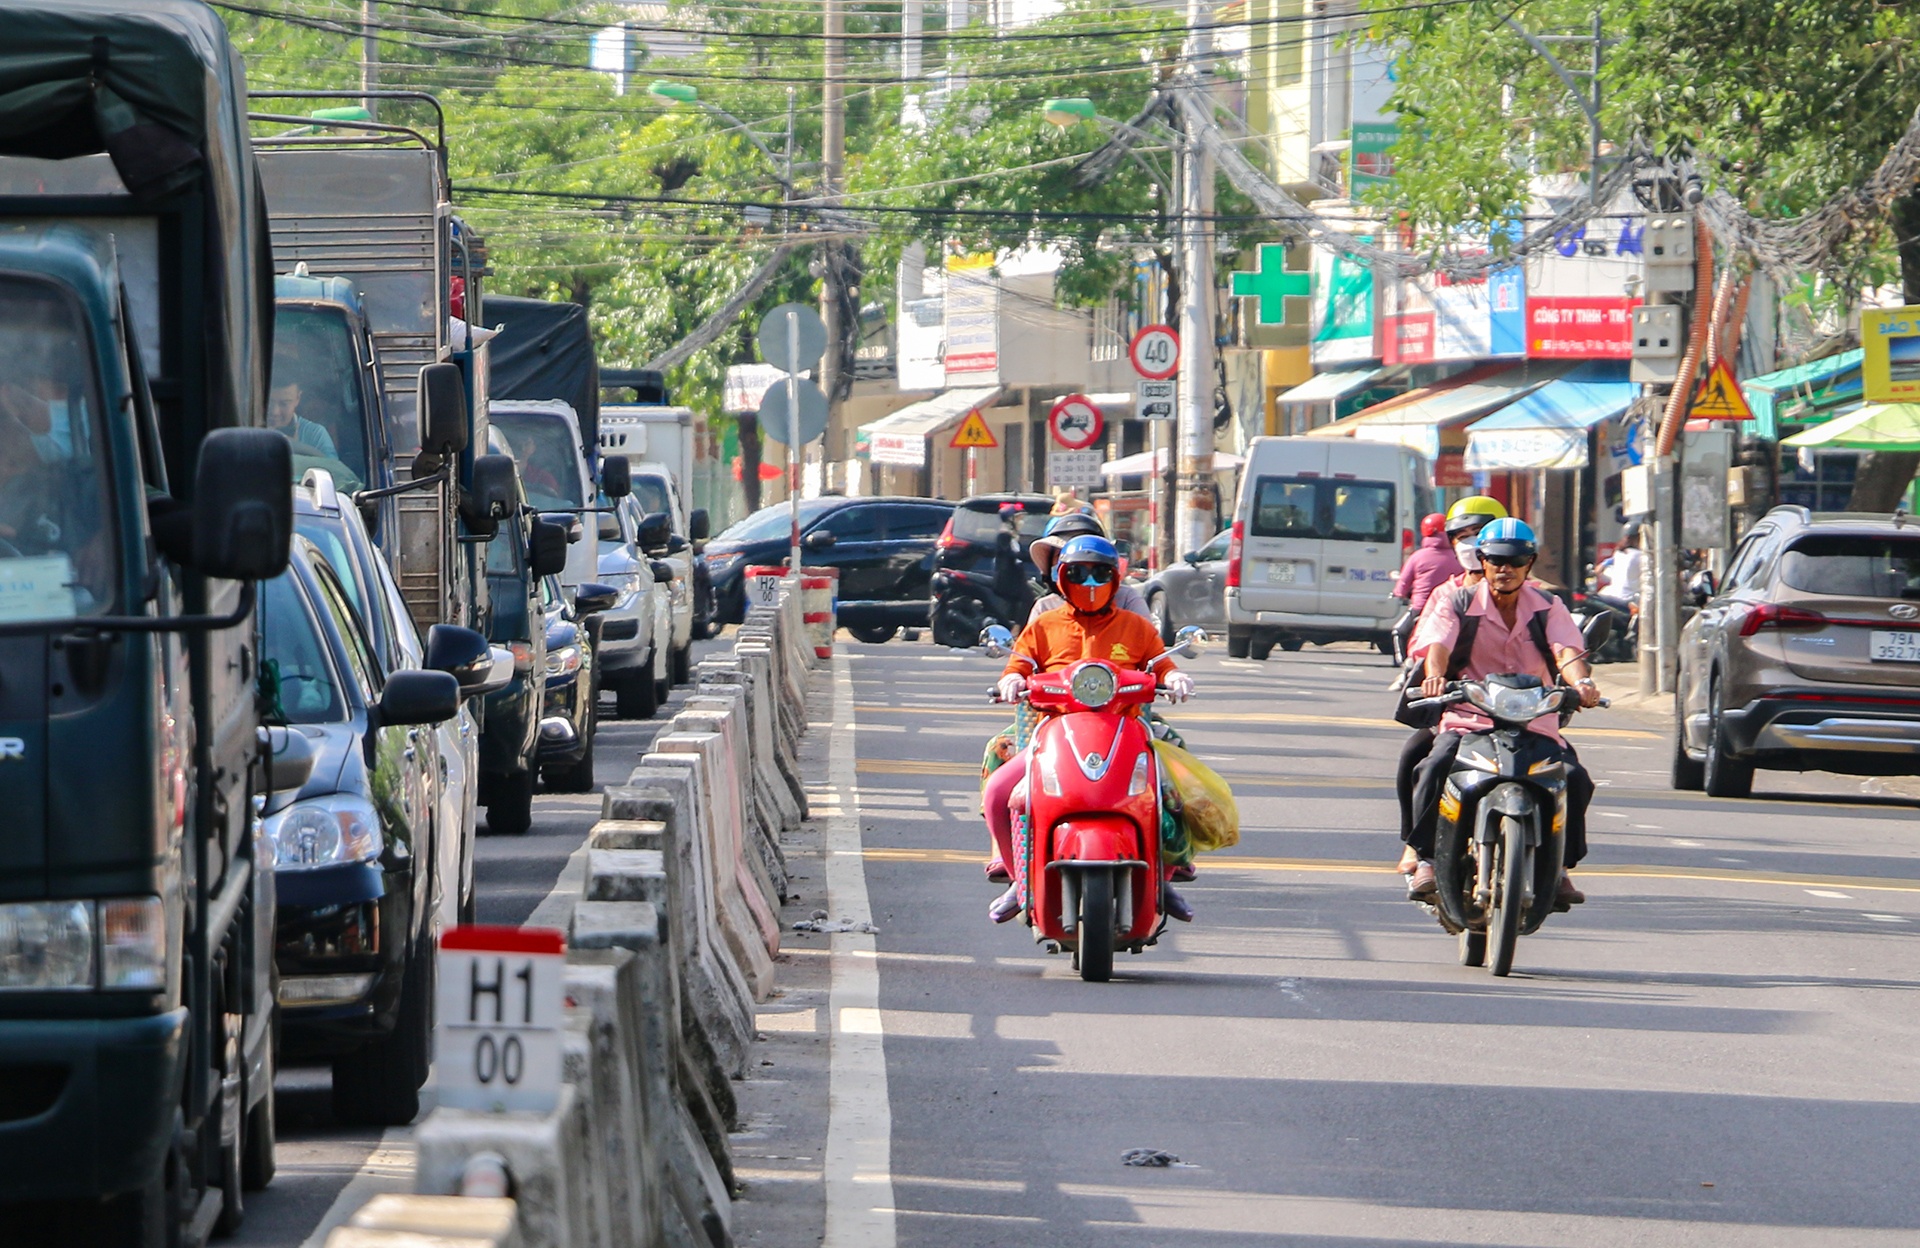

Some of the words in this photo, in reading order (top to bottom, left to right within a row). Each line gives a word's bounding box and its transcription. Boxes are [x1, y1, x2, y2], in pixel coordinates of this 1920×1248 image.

[1145, 340, 1168, 363] 40
[760, 576, 775, 590] H2
[762, 591, 773, 602] 00
[1889, 633, 1914, 645] 79A
[470, 958, 533, 1023] H1
[476, 1032, 524, 1085] 00
